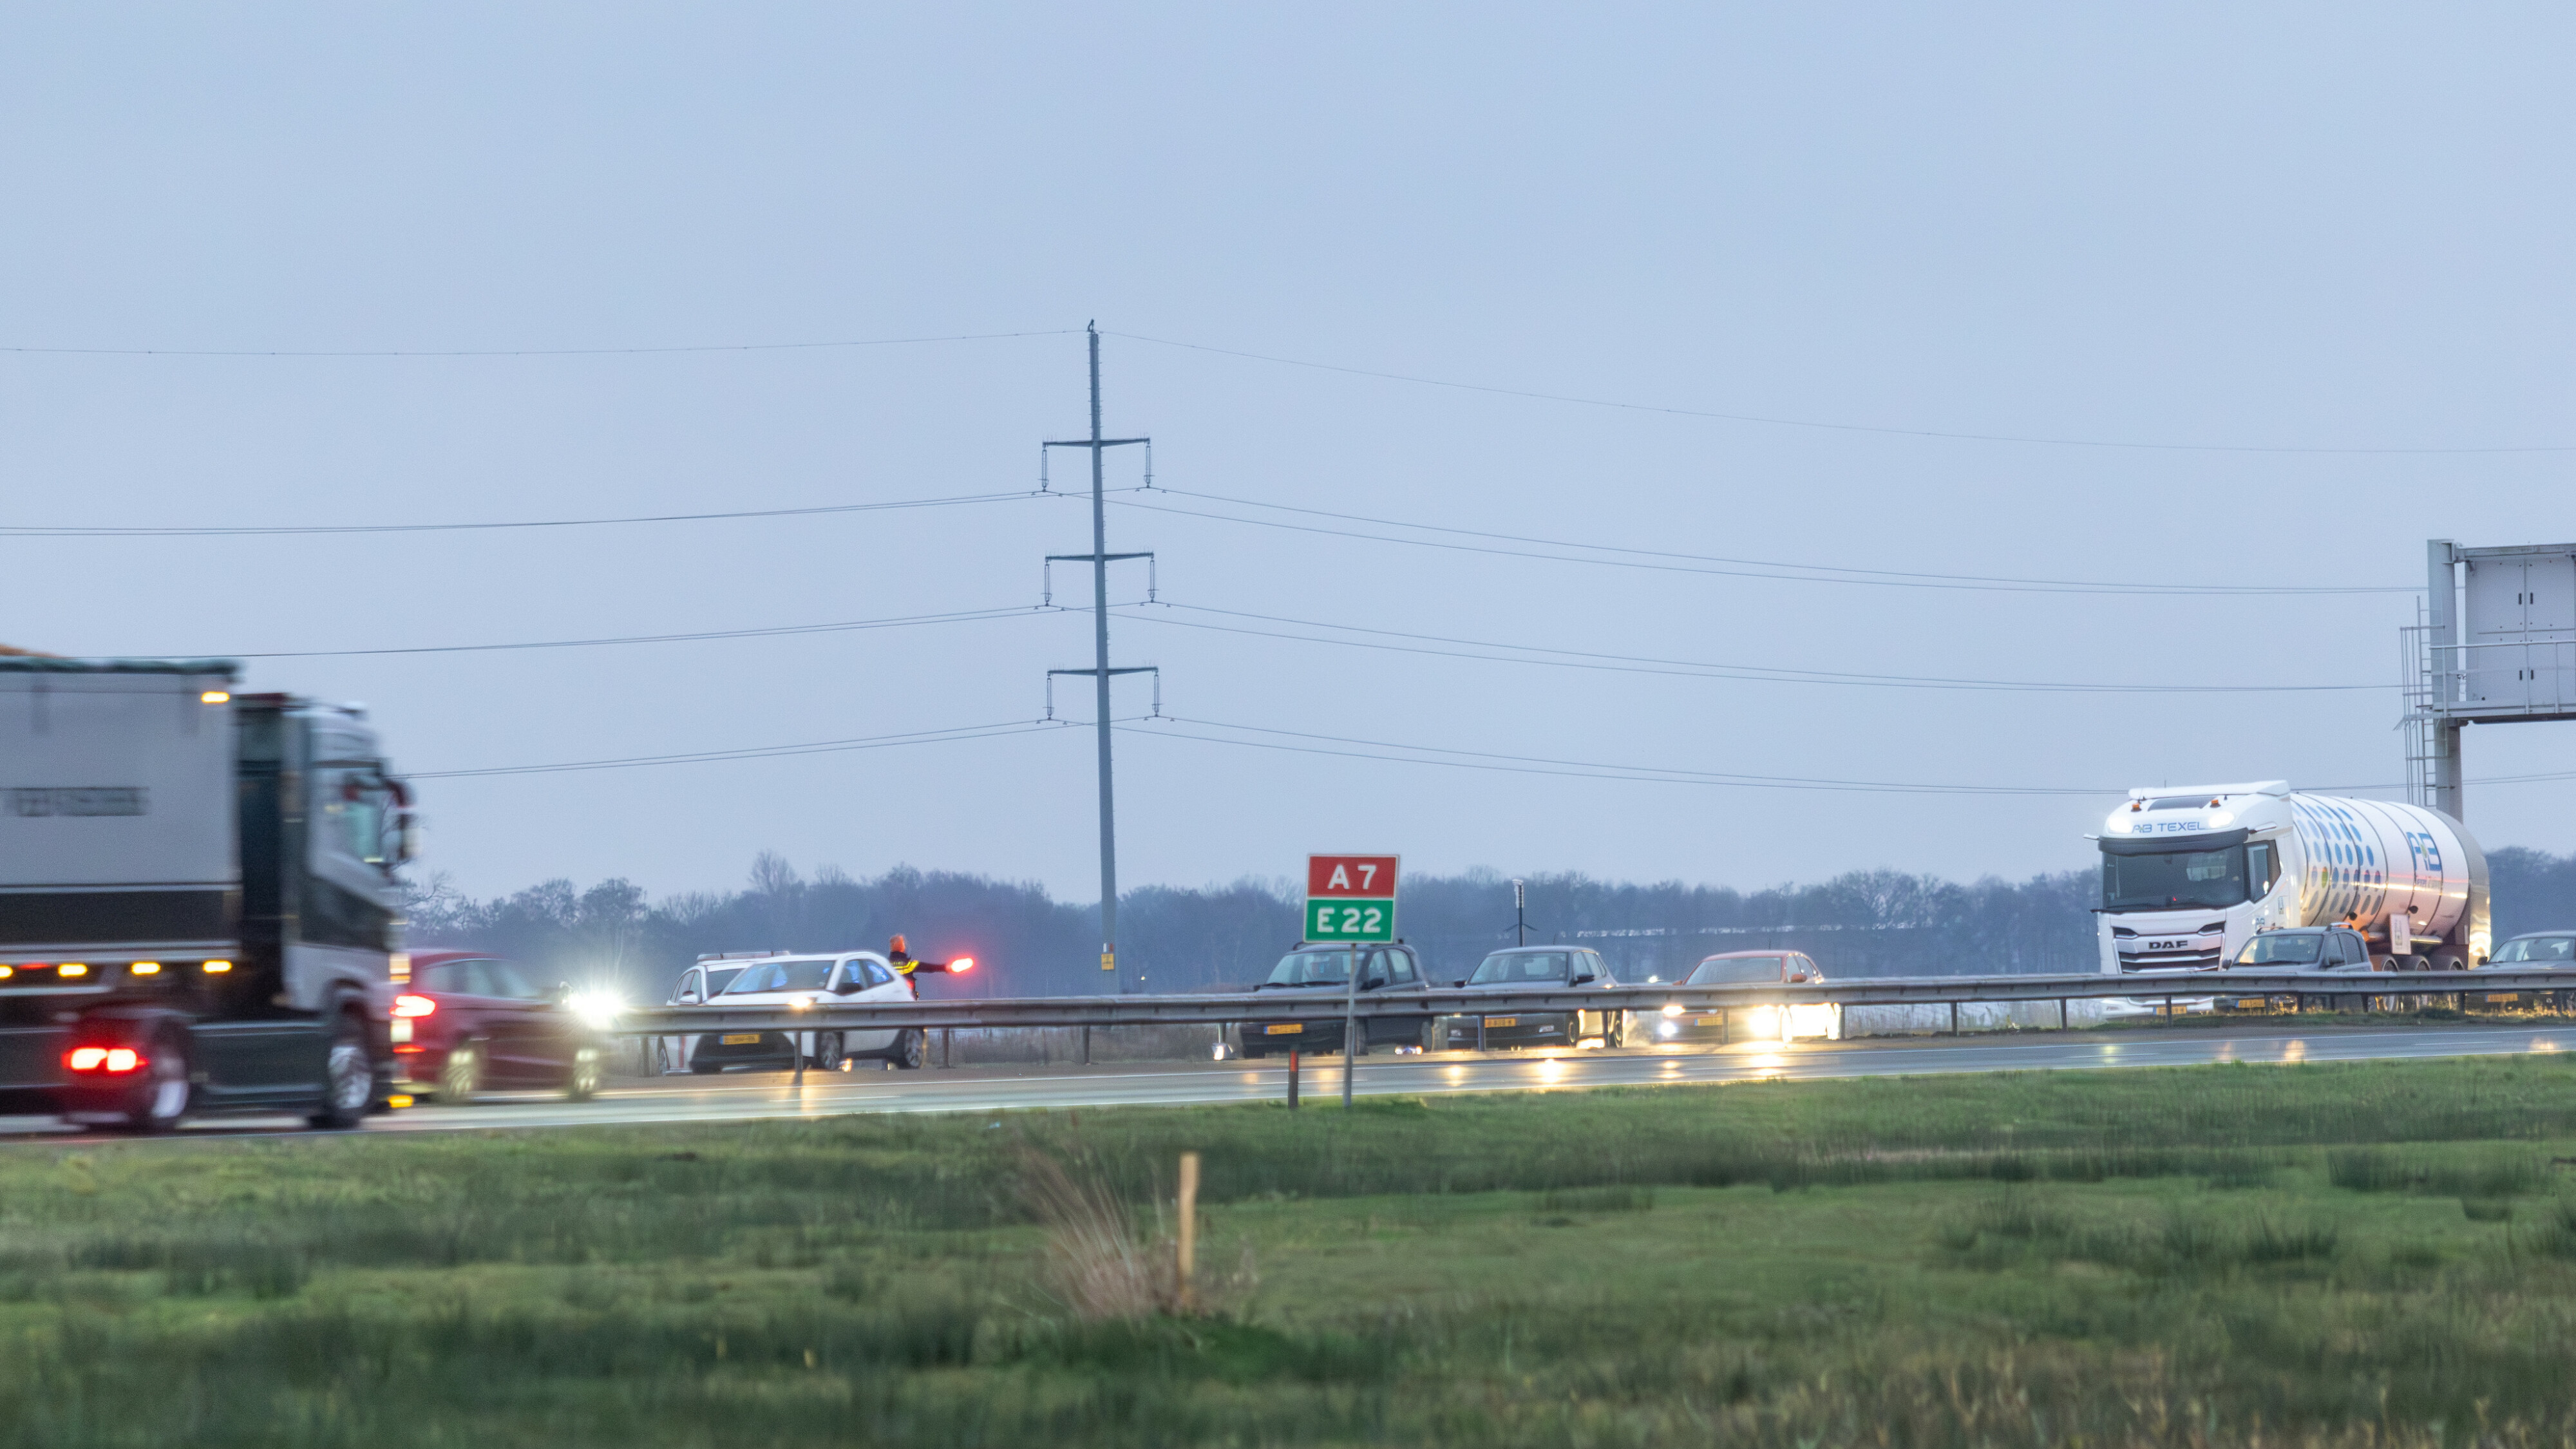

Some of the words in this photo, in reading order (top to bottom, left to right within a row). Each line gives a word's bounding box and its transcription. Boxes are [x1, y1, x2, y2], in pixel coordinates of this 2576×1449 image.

[2132, 824, 2152, 834] AB
[2157, 822, 2206, 832] TEXEL
[2148, 940, 2188, 949] DAF
